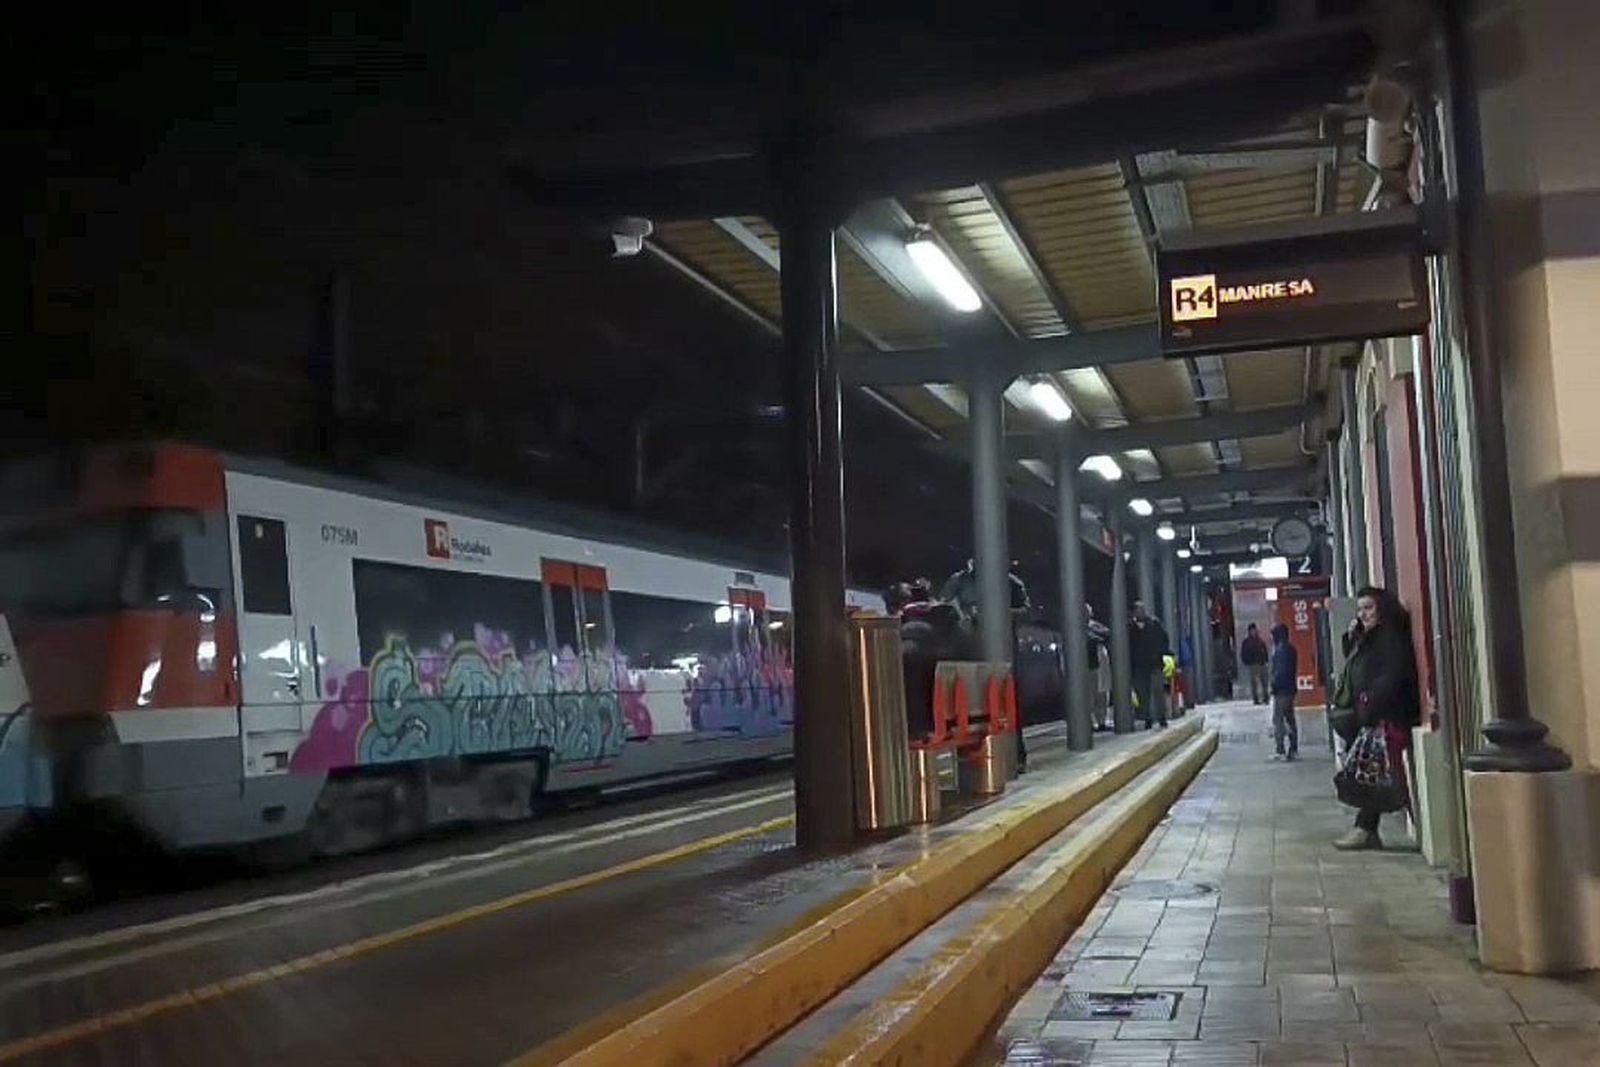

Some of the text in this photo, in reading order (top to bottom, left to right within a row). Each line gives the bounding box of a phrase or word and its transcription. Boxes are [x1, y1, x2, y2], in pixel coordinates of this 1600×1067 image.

[1174, 278, 1314, 313] R4 MANRESA
[1298, 556, 1312, 573] 2
